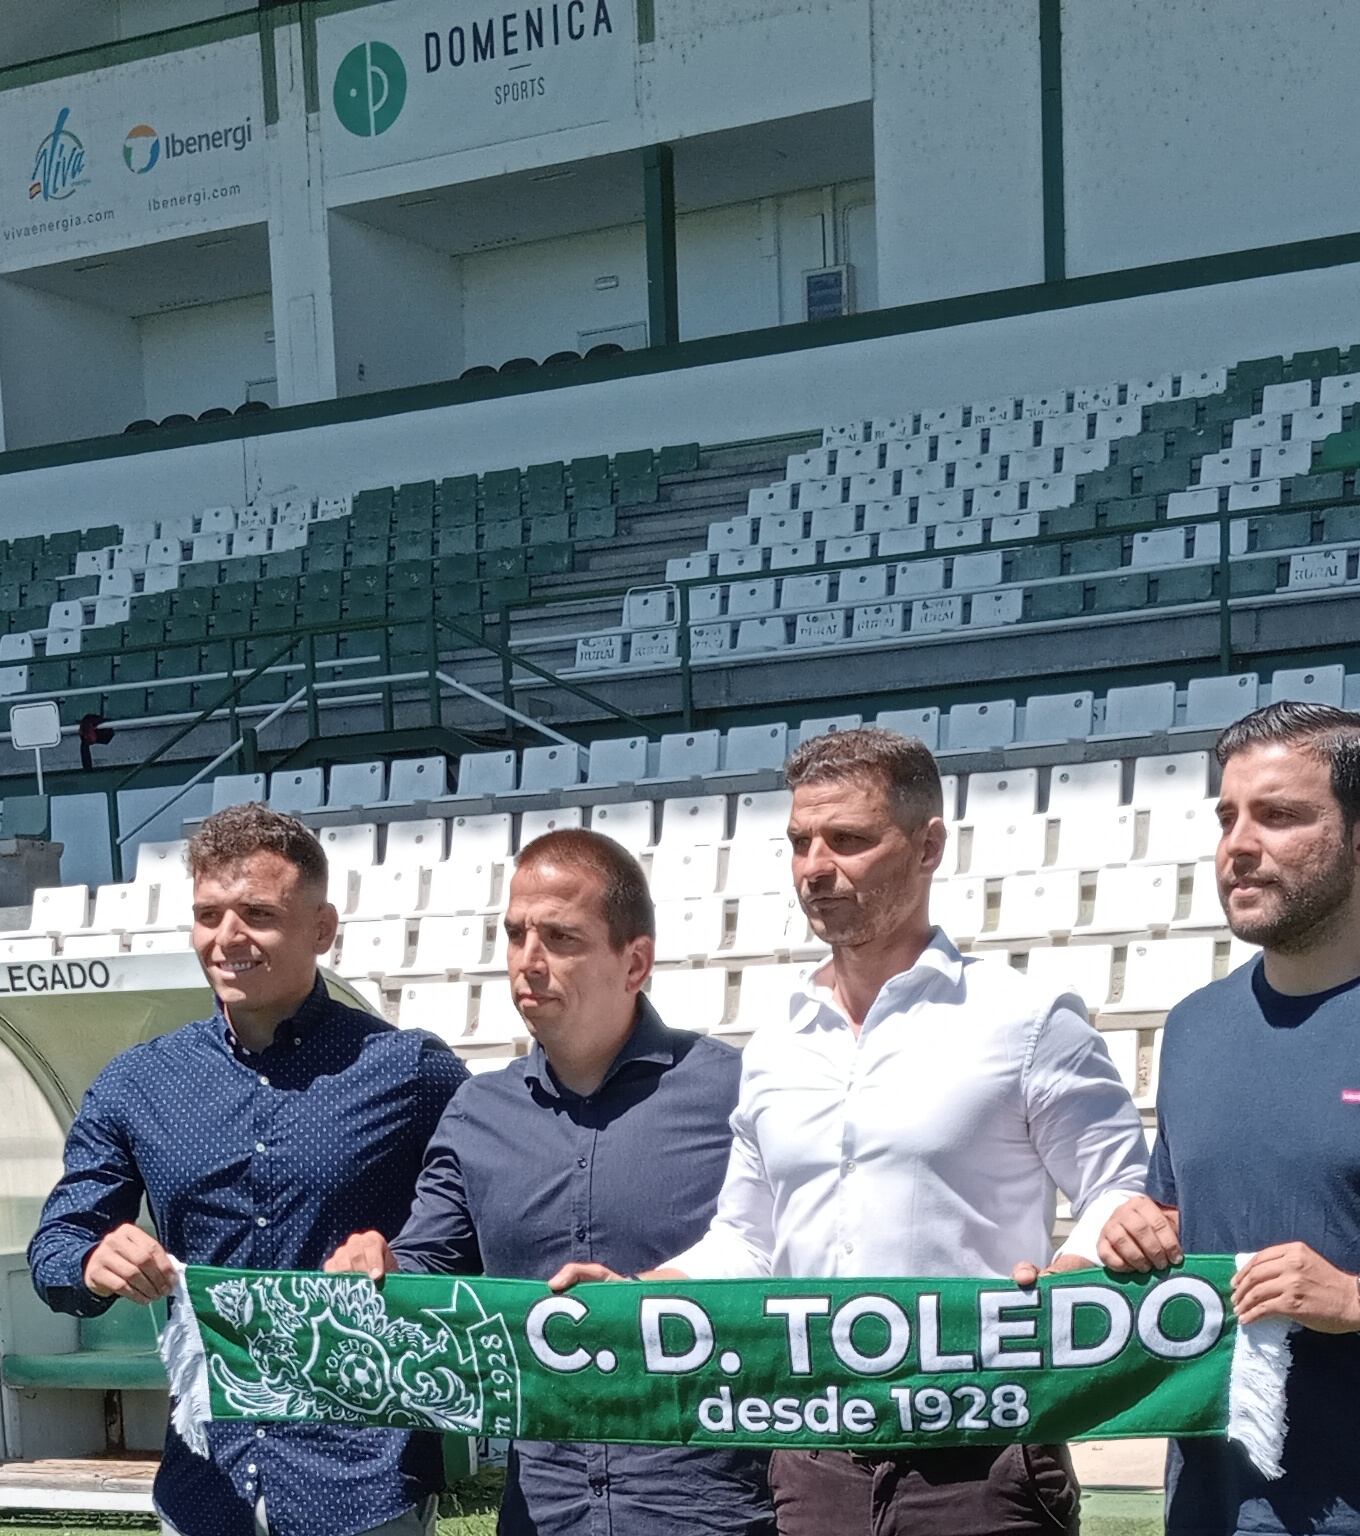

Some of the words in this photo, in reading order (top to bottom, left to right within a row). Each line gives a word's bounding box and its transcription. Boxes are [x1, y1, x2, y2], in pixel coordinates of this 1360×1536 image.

[424, 0, 613, 73] DOMENICA
[495, 77, 545, 105] SPORTS
[31, 107, 86, 202] Viva
[165, 117, 253, 159] Ibenergi
[3, 209, 115, 241] vivaenergia.com
[525, 1295, 617, 1374] C.
[640, 1295, 742, 1375] D.
[764, 1274, 1225, 1375] TOLEDO
[325, 1339, 373, 1379] TOLEDO
[480, 1334, 513, 1402] 1928
[698, 1386, 877, 1434] desde
[891, 1383, 1030, 1433] 1928
